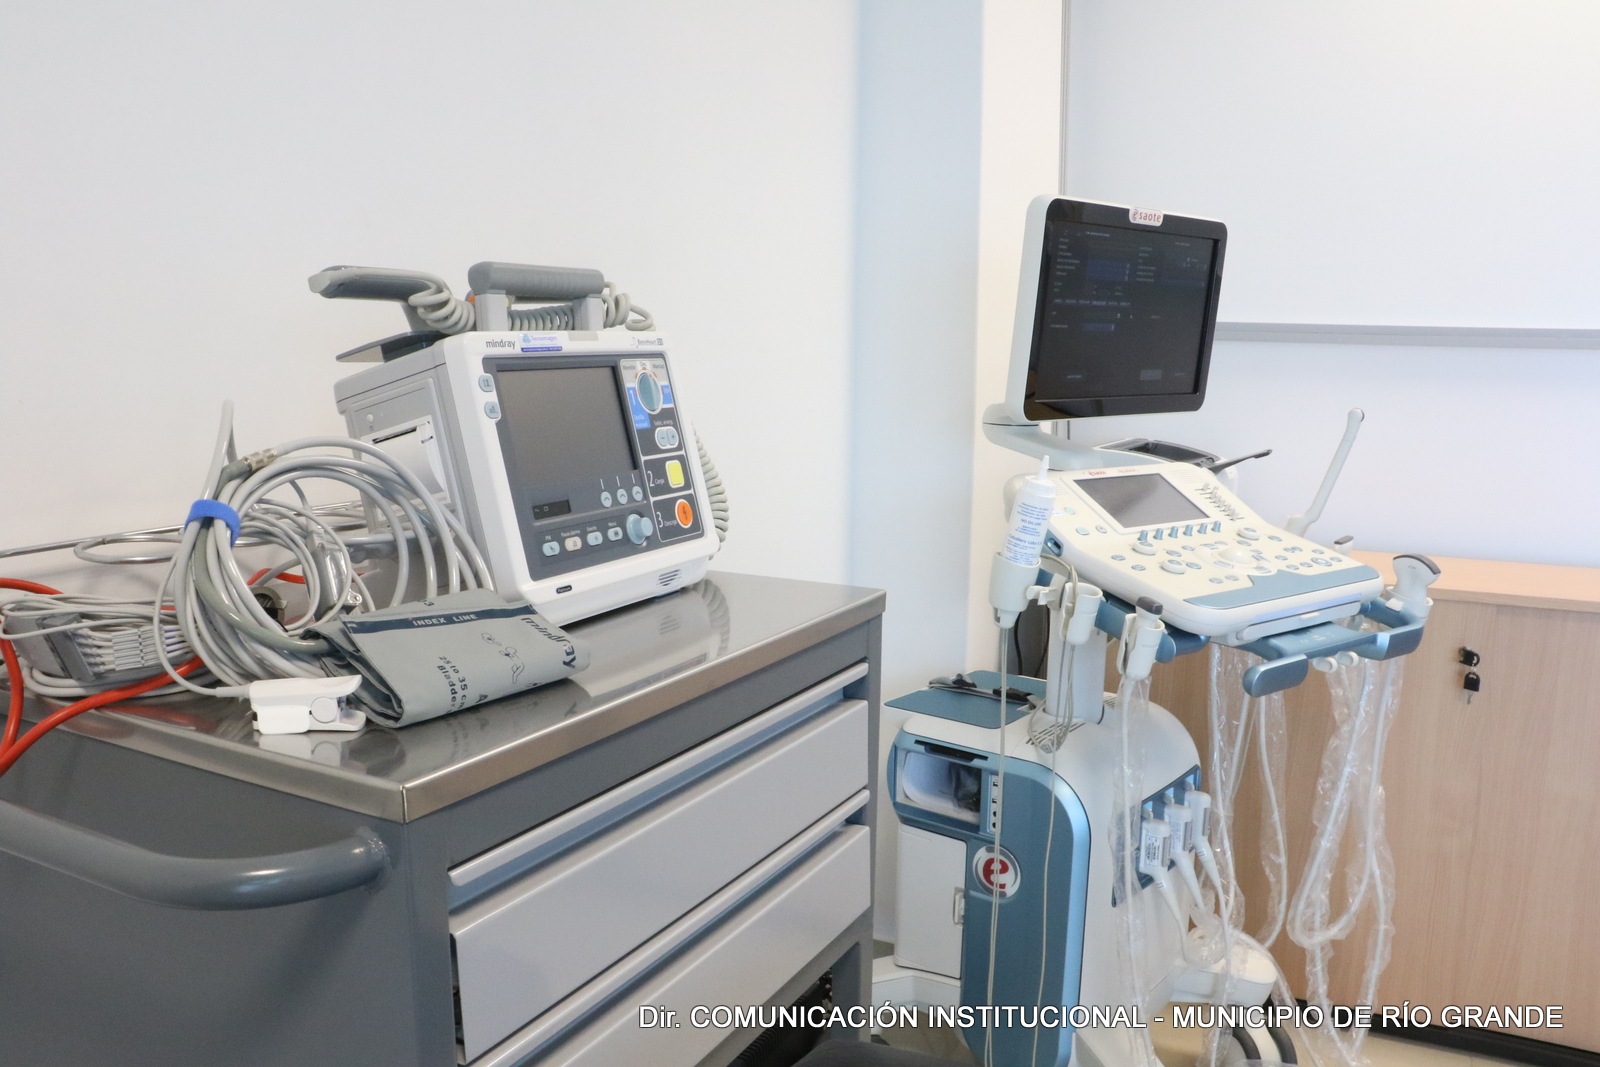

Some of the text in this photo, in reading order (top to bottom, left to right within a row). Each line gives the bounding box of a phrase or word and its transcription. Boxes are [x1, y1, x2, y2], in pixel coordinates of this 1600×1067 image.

[485, 339, 516, 350] mindray
[647, 470, 655, 487] 2
[656, 511, 664, 528] 3
[412, 614, 478, 626] INDEX LINE
[520, 617, 577, 669] mindray
[437, 665, 458, 707] Bladder
[458, 676, 468, 691] 35
